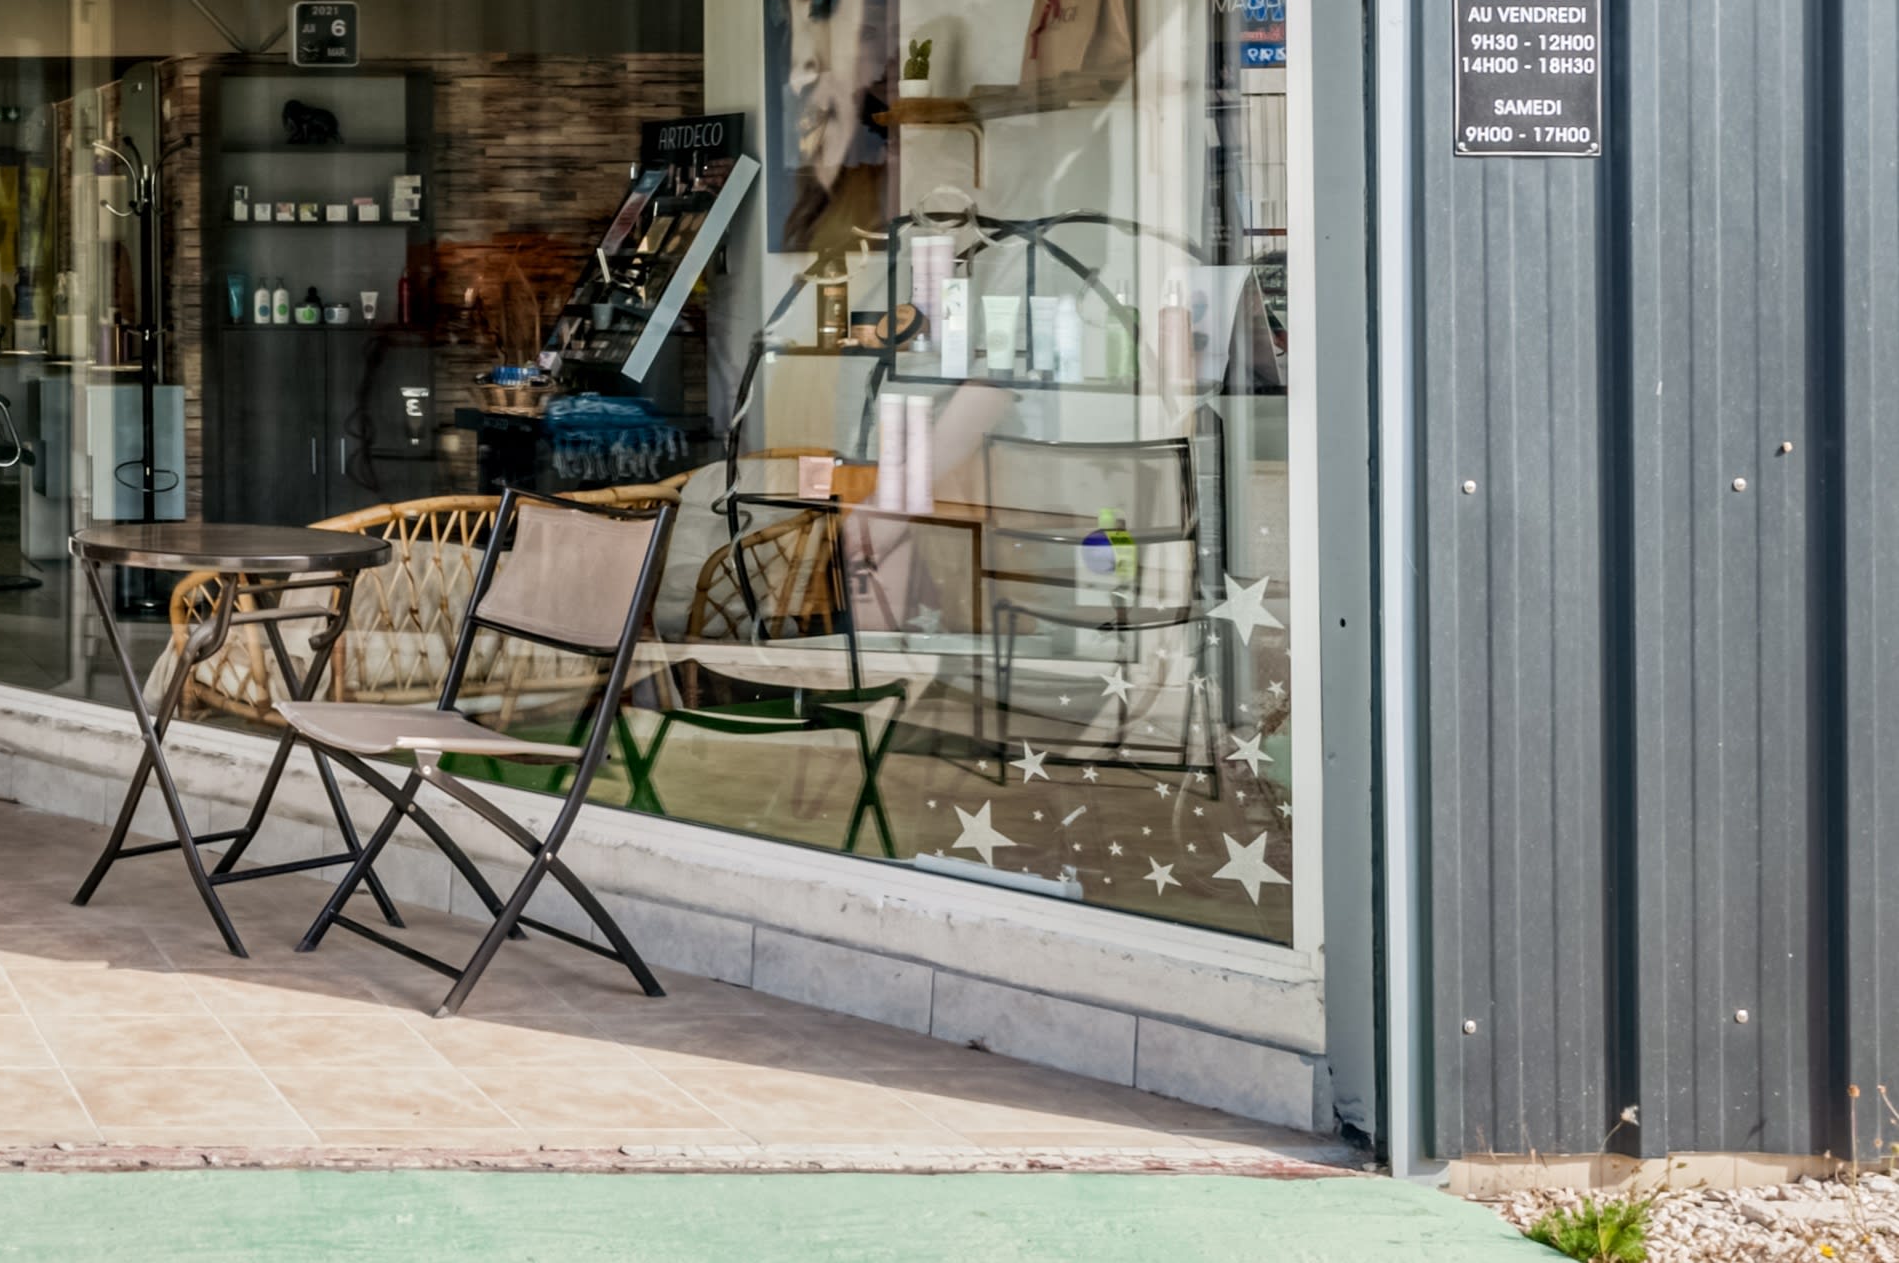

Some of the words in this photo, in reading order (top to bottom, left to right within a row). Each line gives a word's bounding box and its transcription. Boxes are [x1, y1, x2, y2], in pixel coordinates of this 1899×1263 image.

[312, 6, 339, 15] 2021
[1468, 7, 1492, 23] AU
[1497, 7, 1586, 23] VENDREDI
[331, 19, 346, 37] 6
[1471, 34, 1518, 51] 9H30
[1539, 34, 1595, 51] 12H00
[1462, 57, 1518, 74] 14H00
[1539, 57, 1595, 74] 18H30
[1494, 99, 1562, 116] SAMEDI
[658, 122, 723, 150] ARTDECO
[1465, 126, 1513, 142] 9H00
[1533, 126, 1590, 143] 17H00
